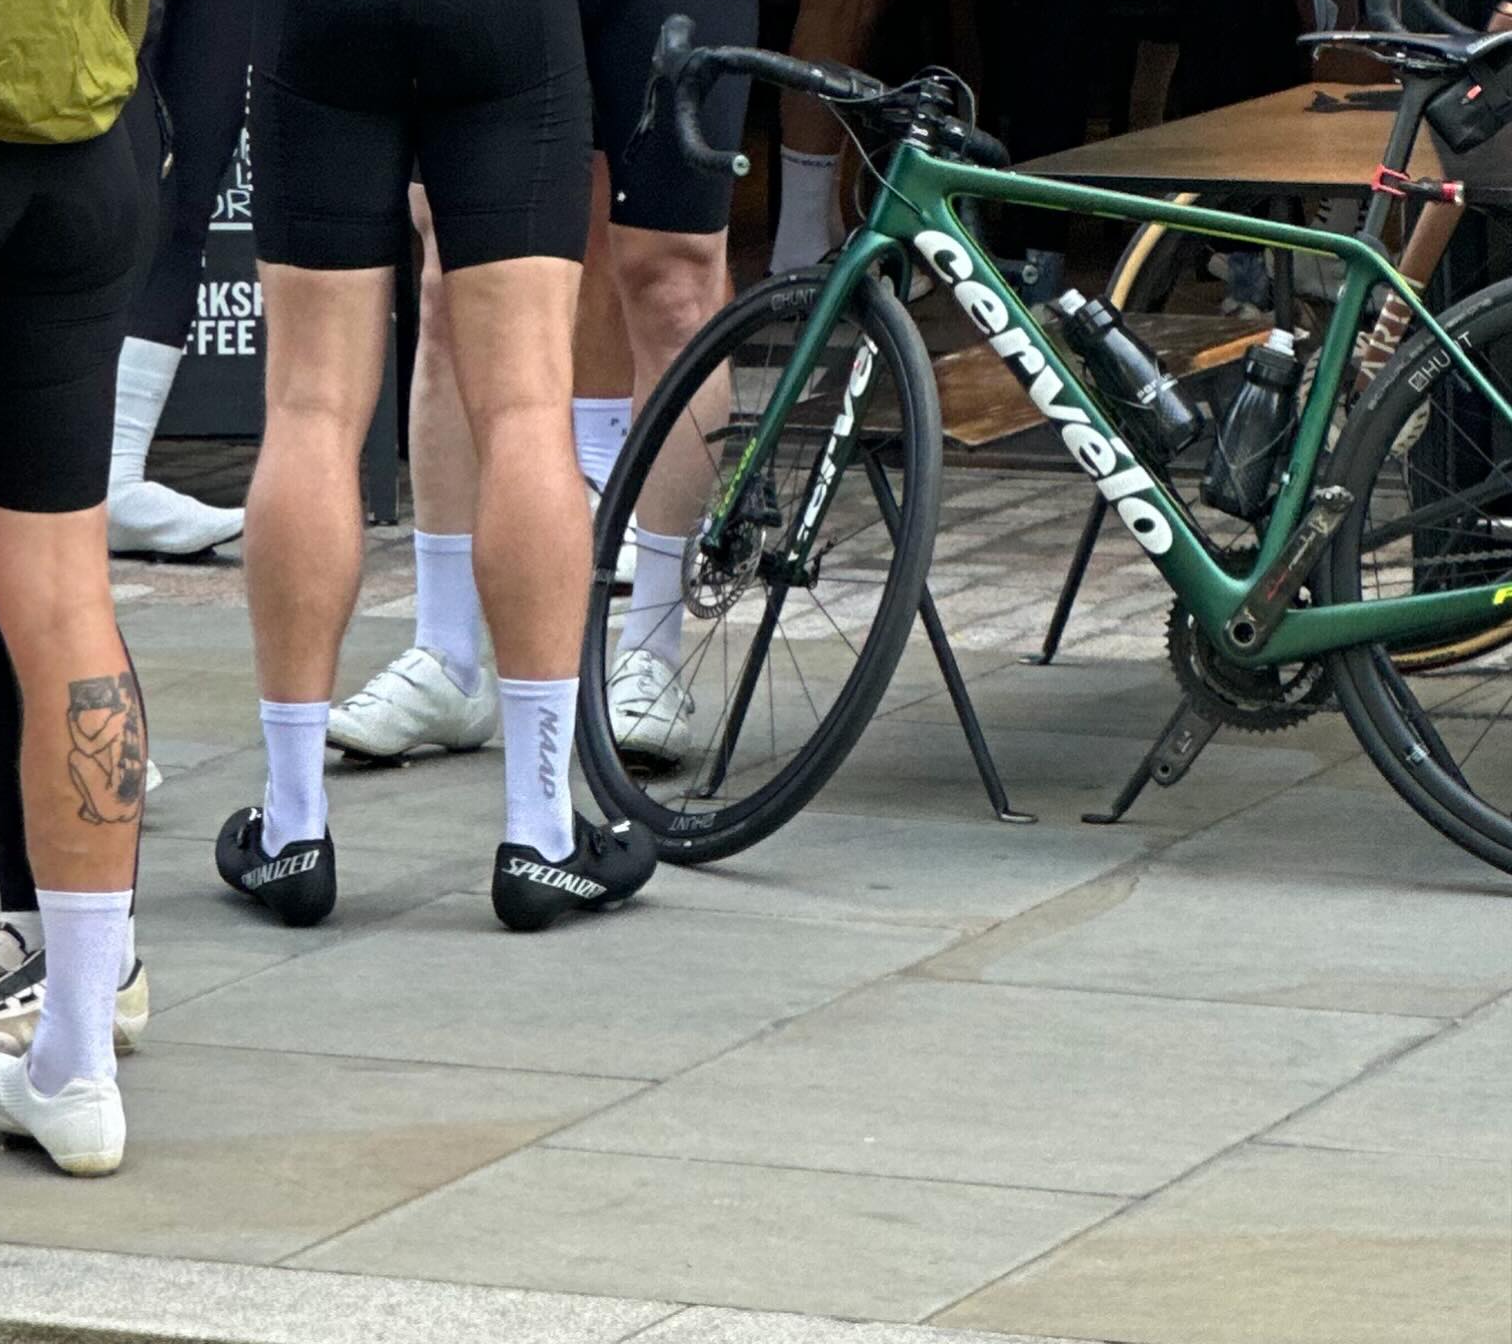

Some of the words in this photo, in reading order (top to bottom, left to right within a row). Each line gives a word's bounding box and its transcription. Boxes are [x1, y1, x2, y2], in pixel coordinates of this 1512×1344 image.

[914, 230, 1173, 554] cervélo
[1421, 331, 1472, 378] HUT
[535, 707, 560, 801] MAAP
